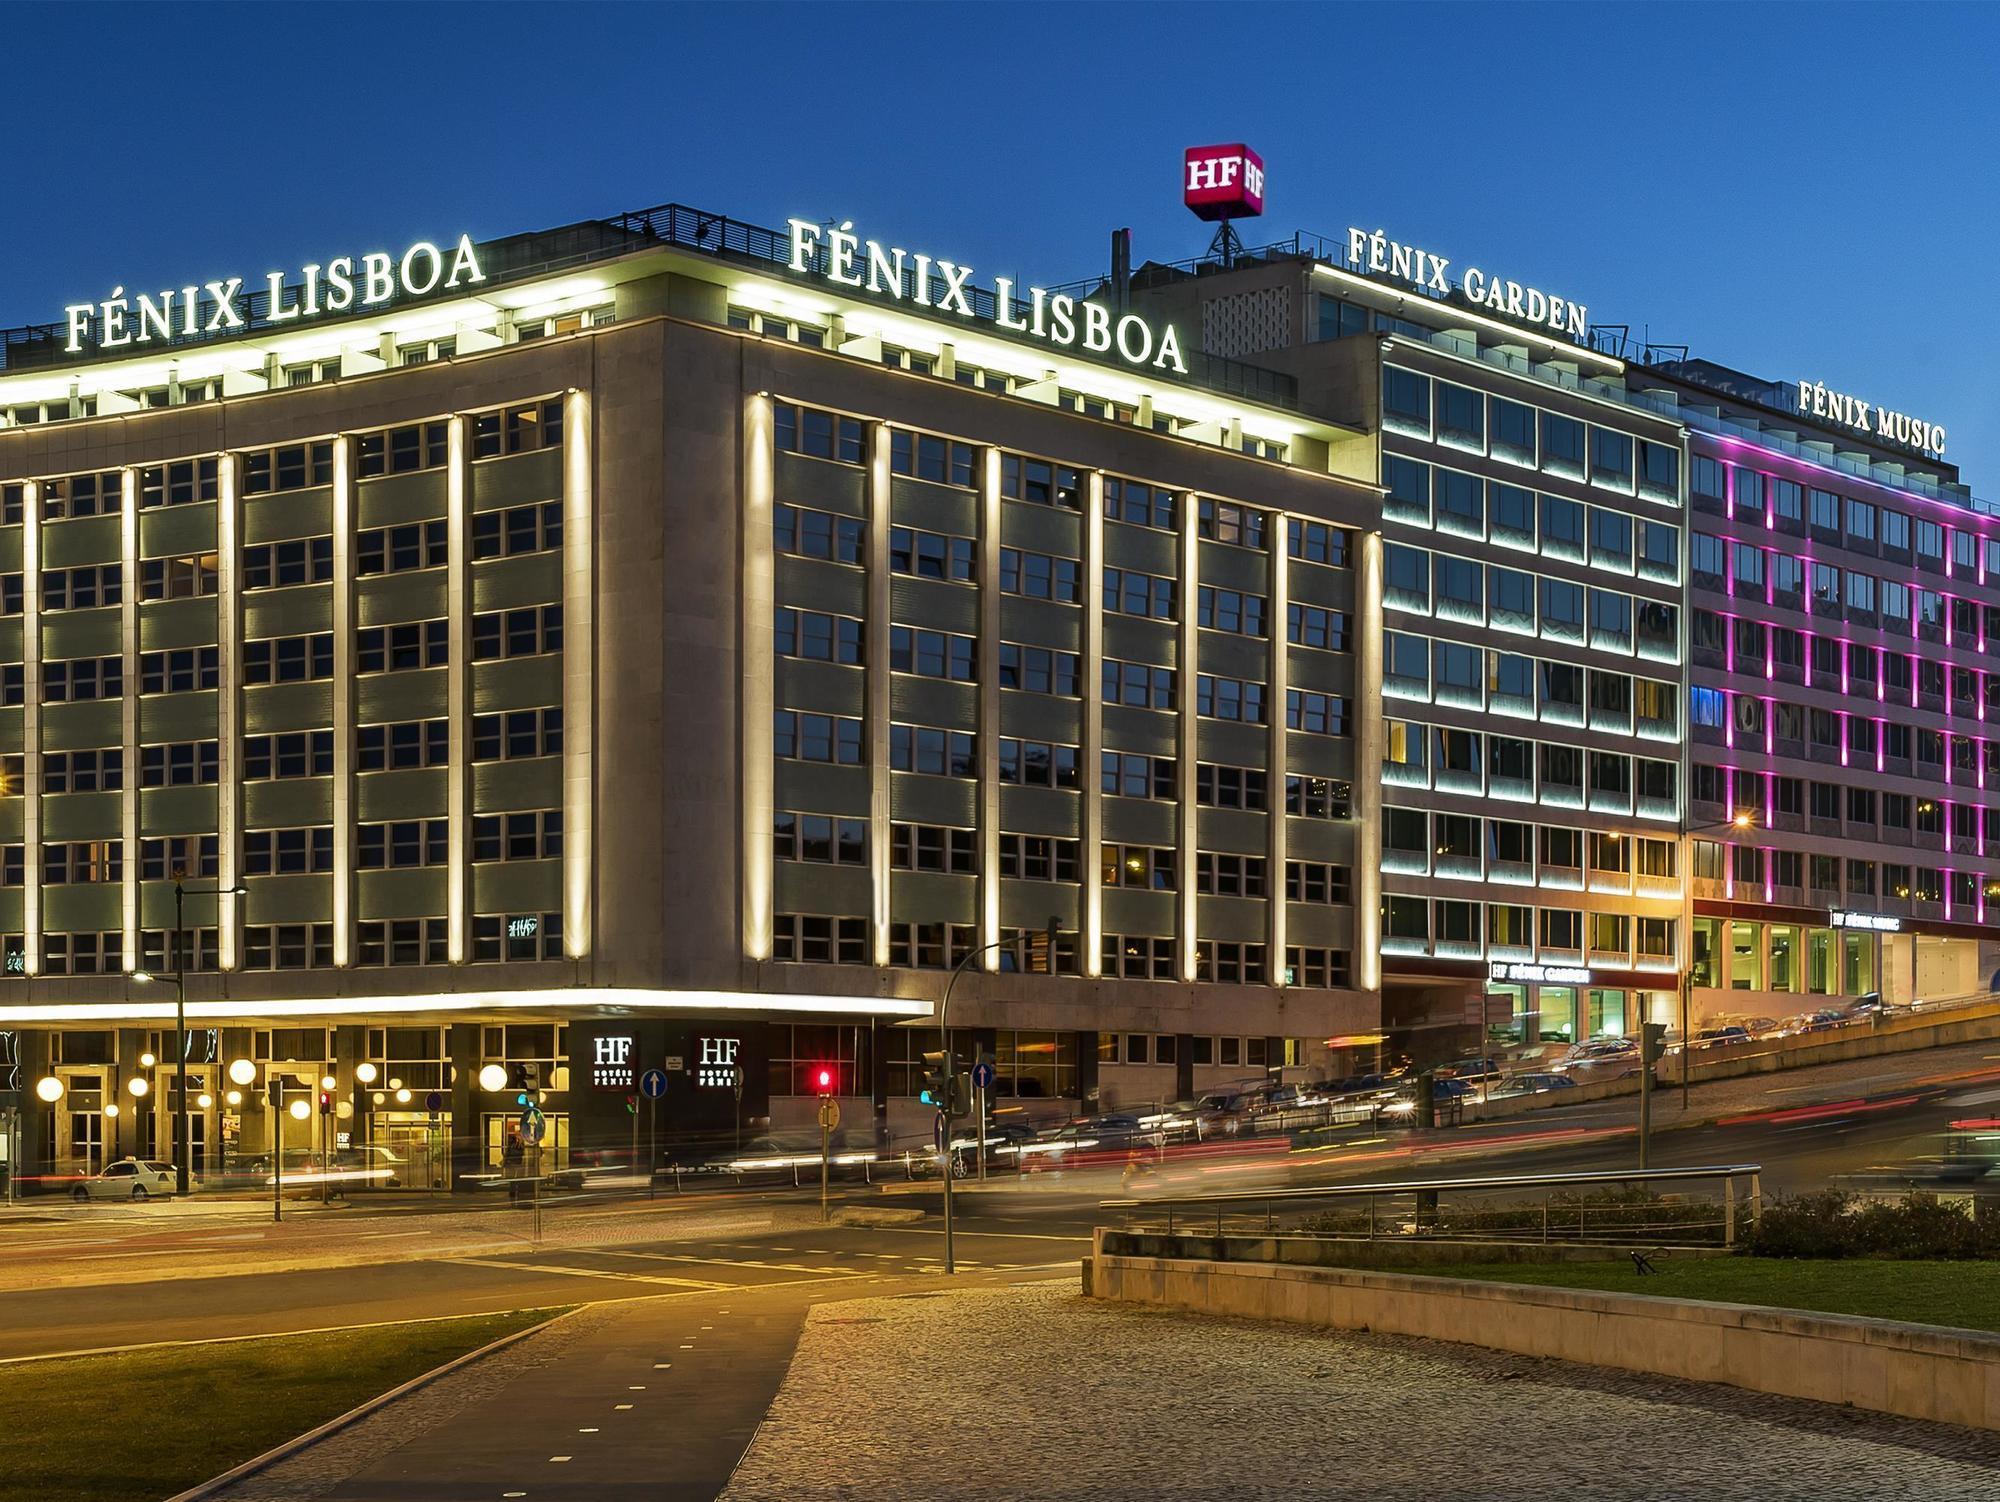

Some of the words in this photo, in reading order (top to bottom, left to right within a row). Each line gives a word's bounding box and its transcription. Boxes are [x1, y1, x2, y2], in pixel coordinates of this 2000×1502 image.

[1186, 155, 1242, 190] HF
[1244, 157, 1264, 199] HF
[64, 278, 244, 352] FÉNIX
[266, 233, 486, 321] LISBOA
[787, 217, 975, 317] FÉNIX
[994, 277, 1189, 374] LISBOA
[1348, 227, 1450, 293] FÉNIX
[1463, 268, 1587, 337] GARDEN
[1798, 380, 1870, 431] FÉNIX
[1876, 406, 1946, 455] MUSIC
[1492, 964, 1507, 978] HF
[593, 1037, 632, 1065] HF
[700, 1038, 740, 1065] HF
[594, 1077, 632, 1086] FÉNIX
[700, 1077, 736, 1086] FÉNI
